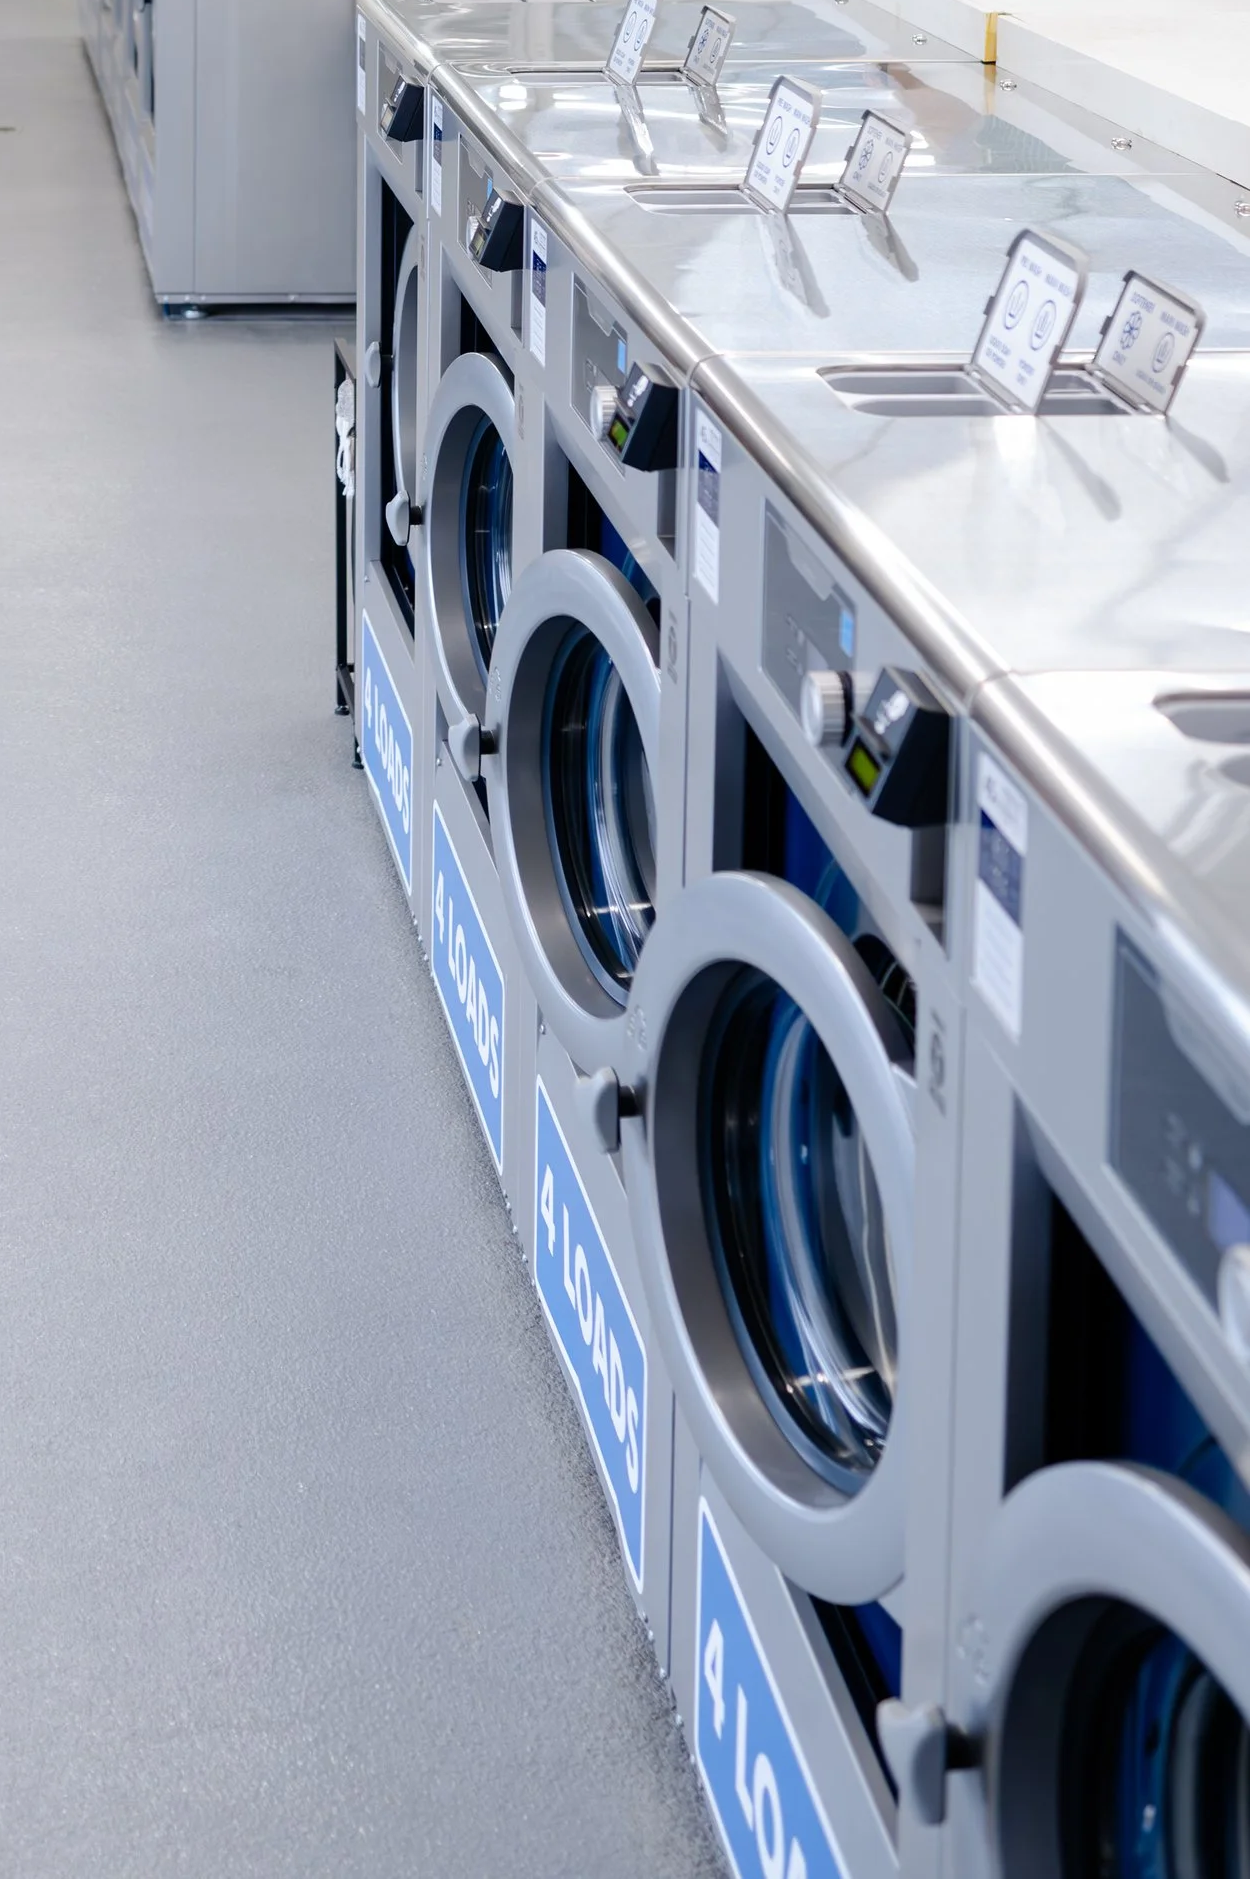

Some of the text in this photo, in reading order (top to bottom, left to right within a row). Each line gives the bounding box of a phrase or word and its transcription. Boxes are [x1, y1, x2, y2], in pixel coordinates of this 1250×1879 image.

[364, 667, 410, 834] 4 LOADS
[435, 869, 499, 1099] 4 LOADS
[541, 1163, 639, 1494] 4 LOADS
[704, 1618, 807, 1879] 4 LO
